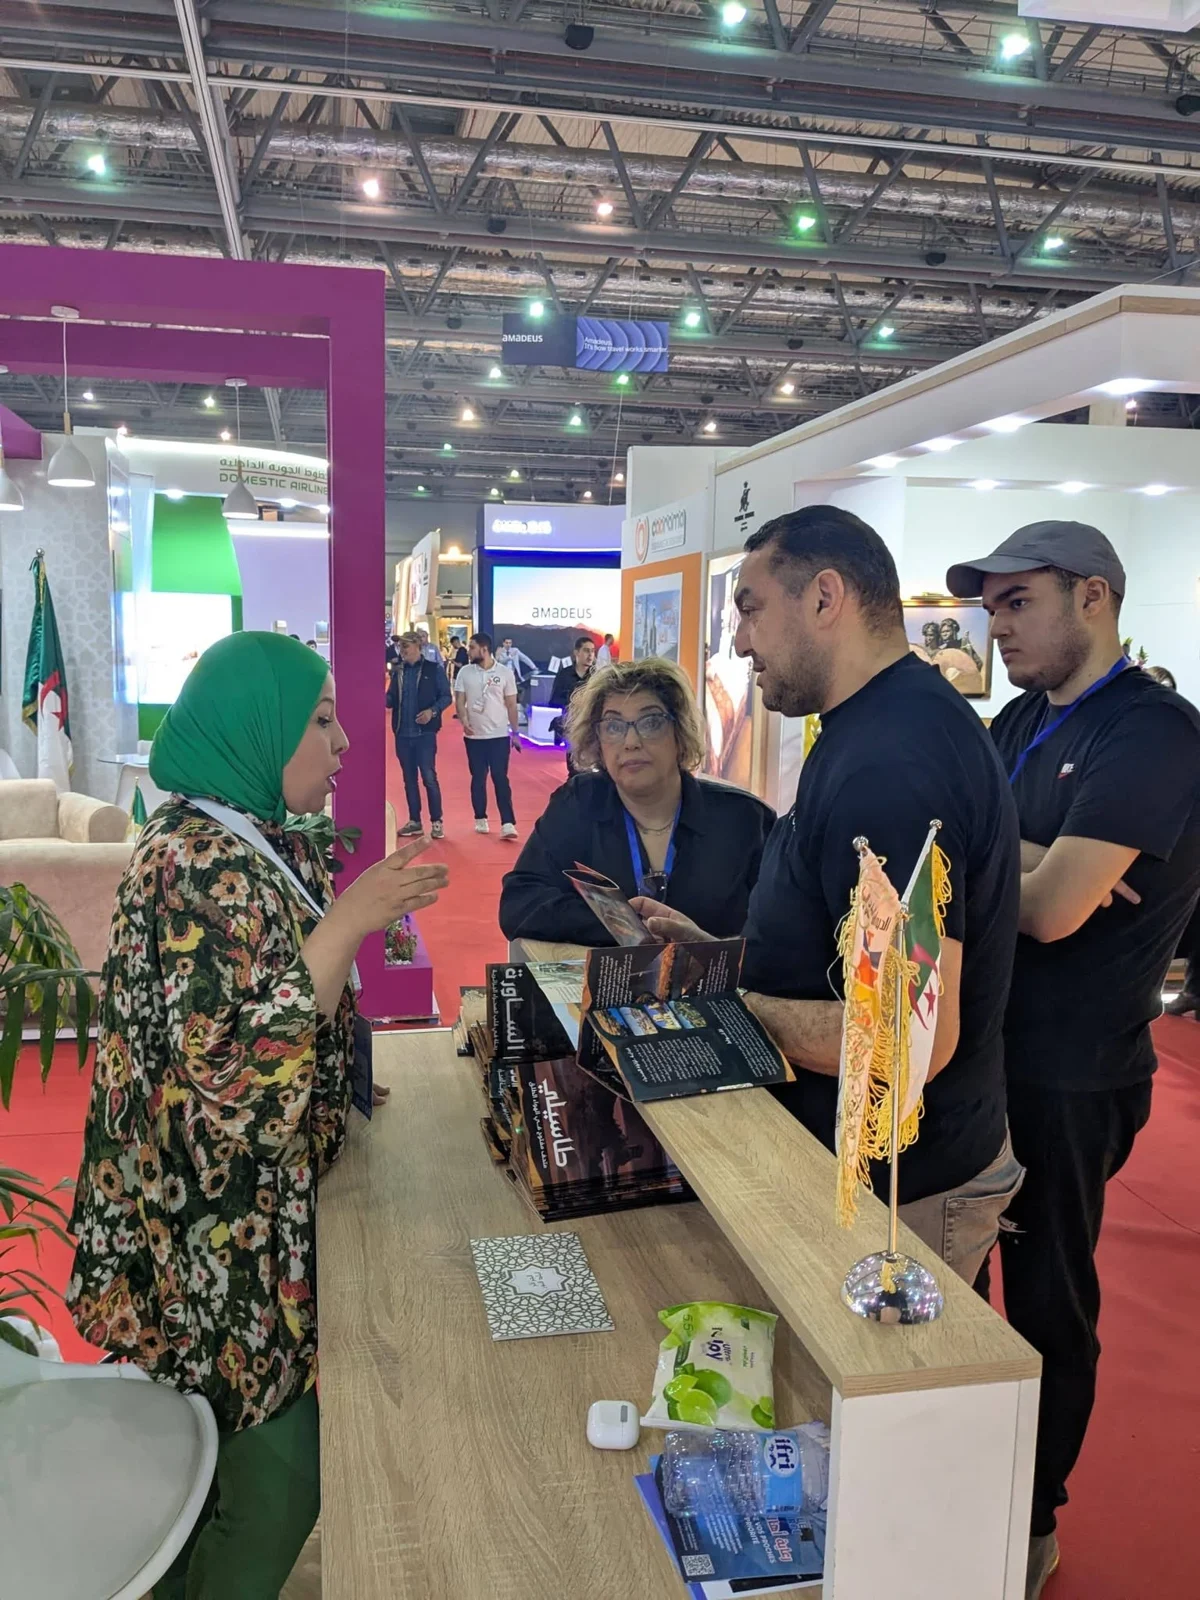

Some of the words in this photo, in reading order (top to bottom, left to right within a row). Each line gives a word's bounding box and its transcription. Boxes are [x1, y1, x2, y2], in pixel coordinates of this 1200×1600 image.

[500, 967, 526, 1051] الساورة
[532, 1099, 541, 1115] الهواء
[533, 1116, 541, 1131] في
[538, 1078, 575, 1167] طاسيلي
[536, 1131, 545, 1149] مفتوح
[541, 1150, 549, 1169] متحف
[775, 1439, 795, 1469] ifri
[760, 1535, 776, 1564] PROCHES
[773, 1537, 793, 1562] رعاية
